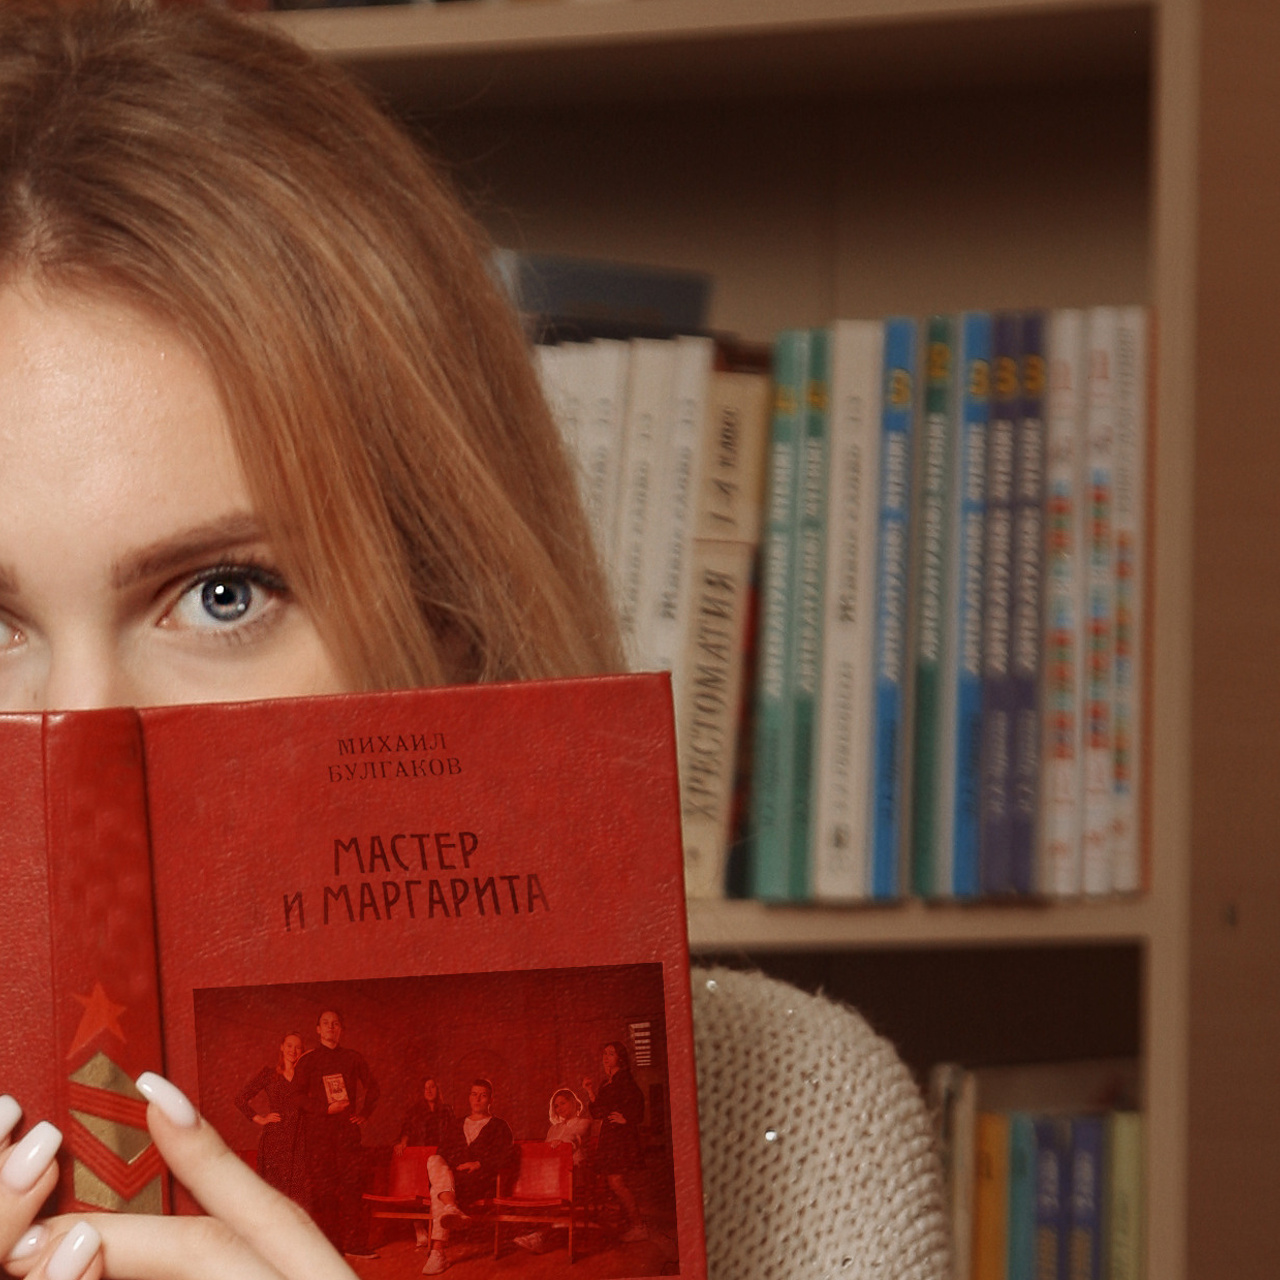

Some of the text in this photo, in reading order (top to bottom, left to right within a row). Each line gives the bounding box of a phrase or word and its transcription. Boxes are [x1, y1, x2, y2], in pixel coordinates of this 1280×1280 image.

[928, 341, 952, 379] 2
[969, 359, 990, 398] 3
[996, 356, 1018, 398] 3
[1023, 354, 1046, 395] 3
[889, 368, 911, 406] 3
[683, 568, 737, 824] ХРЕСТОМАТИЯ
[337, 731, 448, 757] МИХАИЛ
[327, 757, 464, 784] БУЛГАКОВ
[334, 830, 480, 877] МАСТЕР
[283, 873, 550, 932] И МАРГАРИТА
